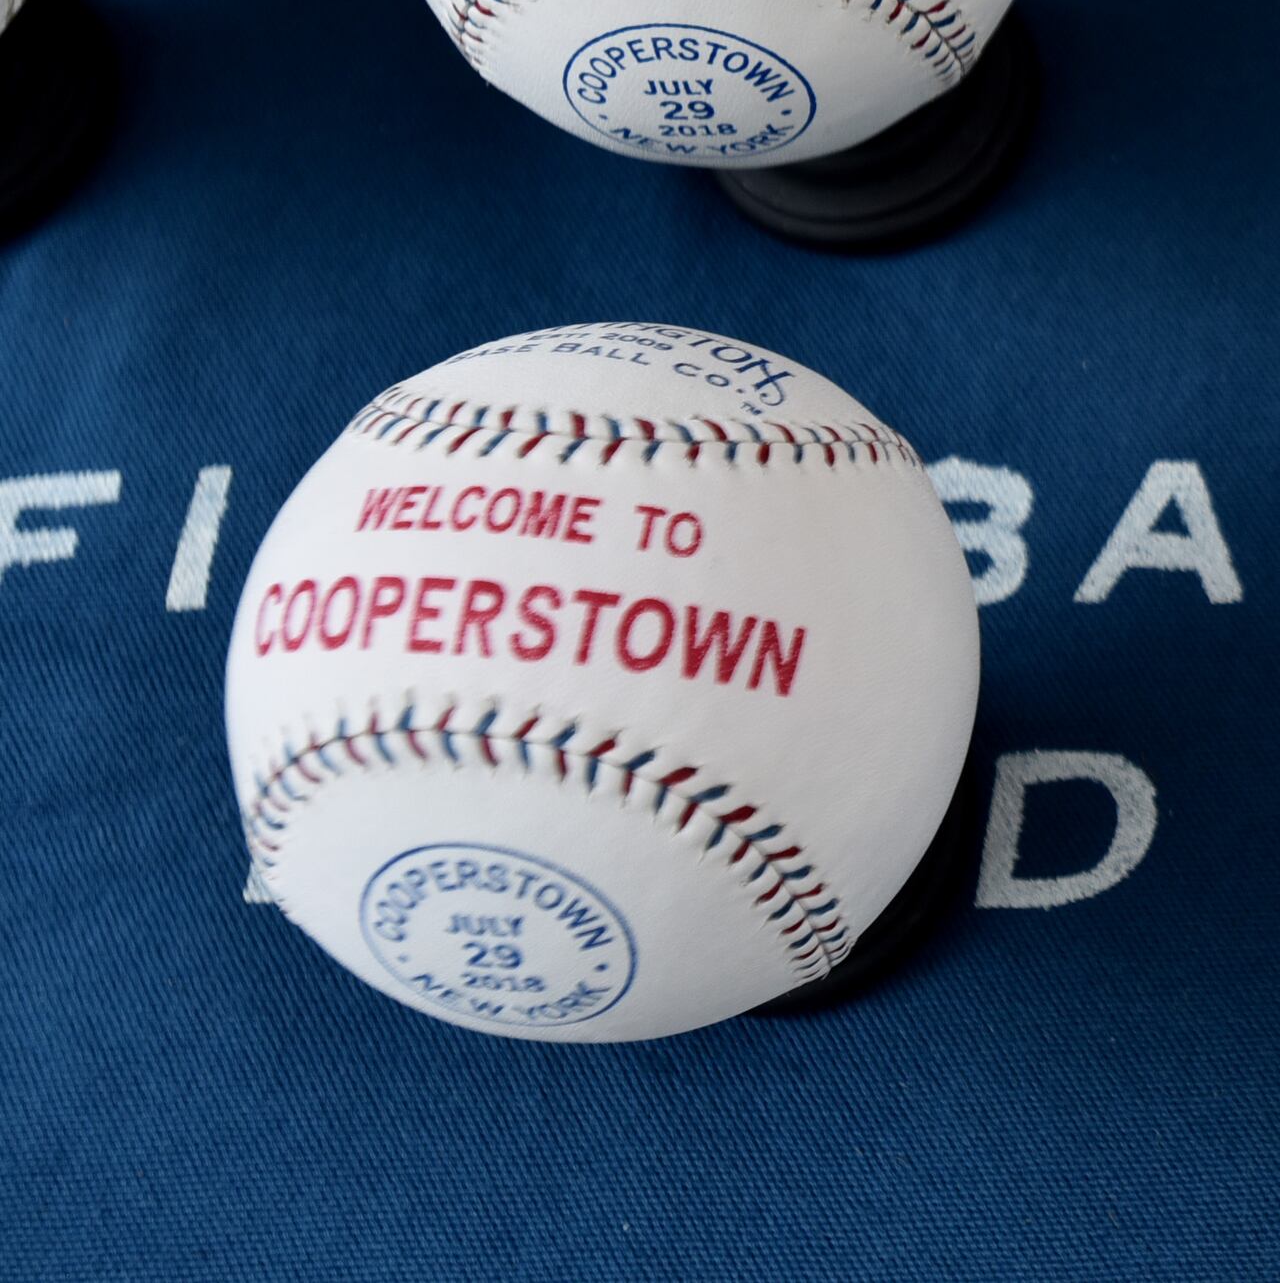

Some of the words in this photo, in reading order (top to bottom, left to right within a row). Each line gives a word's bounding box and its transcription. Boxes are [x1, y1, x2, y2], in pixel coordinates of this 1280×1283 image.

[576, 37, 795, 105] COOPERSTOWN
[643, 78, 714, 96] JULY
[659, 100, 715, 120] 29
[610, 126, 697, 154] NEW
[707, 123, 794, 155] YORK
[658, 123, 738, 137] 2018
[600, 332, 673, 351] 2009
[552, 342, 651, 365] BALL
[673, 362, 744, 394] CO.
[356, 484, 603, 543] WELCOME
[634, 505, 702, 557] TO
[254, 575, 808, 697] COOPERSTOWN
[374, 860, 614, 951] COOPERSTOWN
[446, 914, 523, 936] JULY
[462, 941, 522, 968] 29
